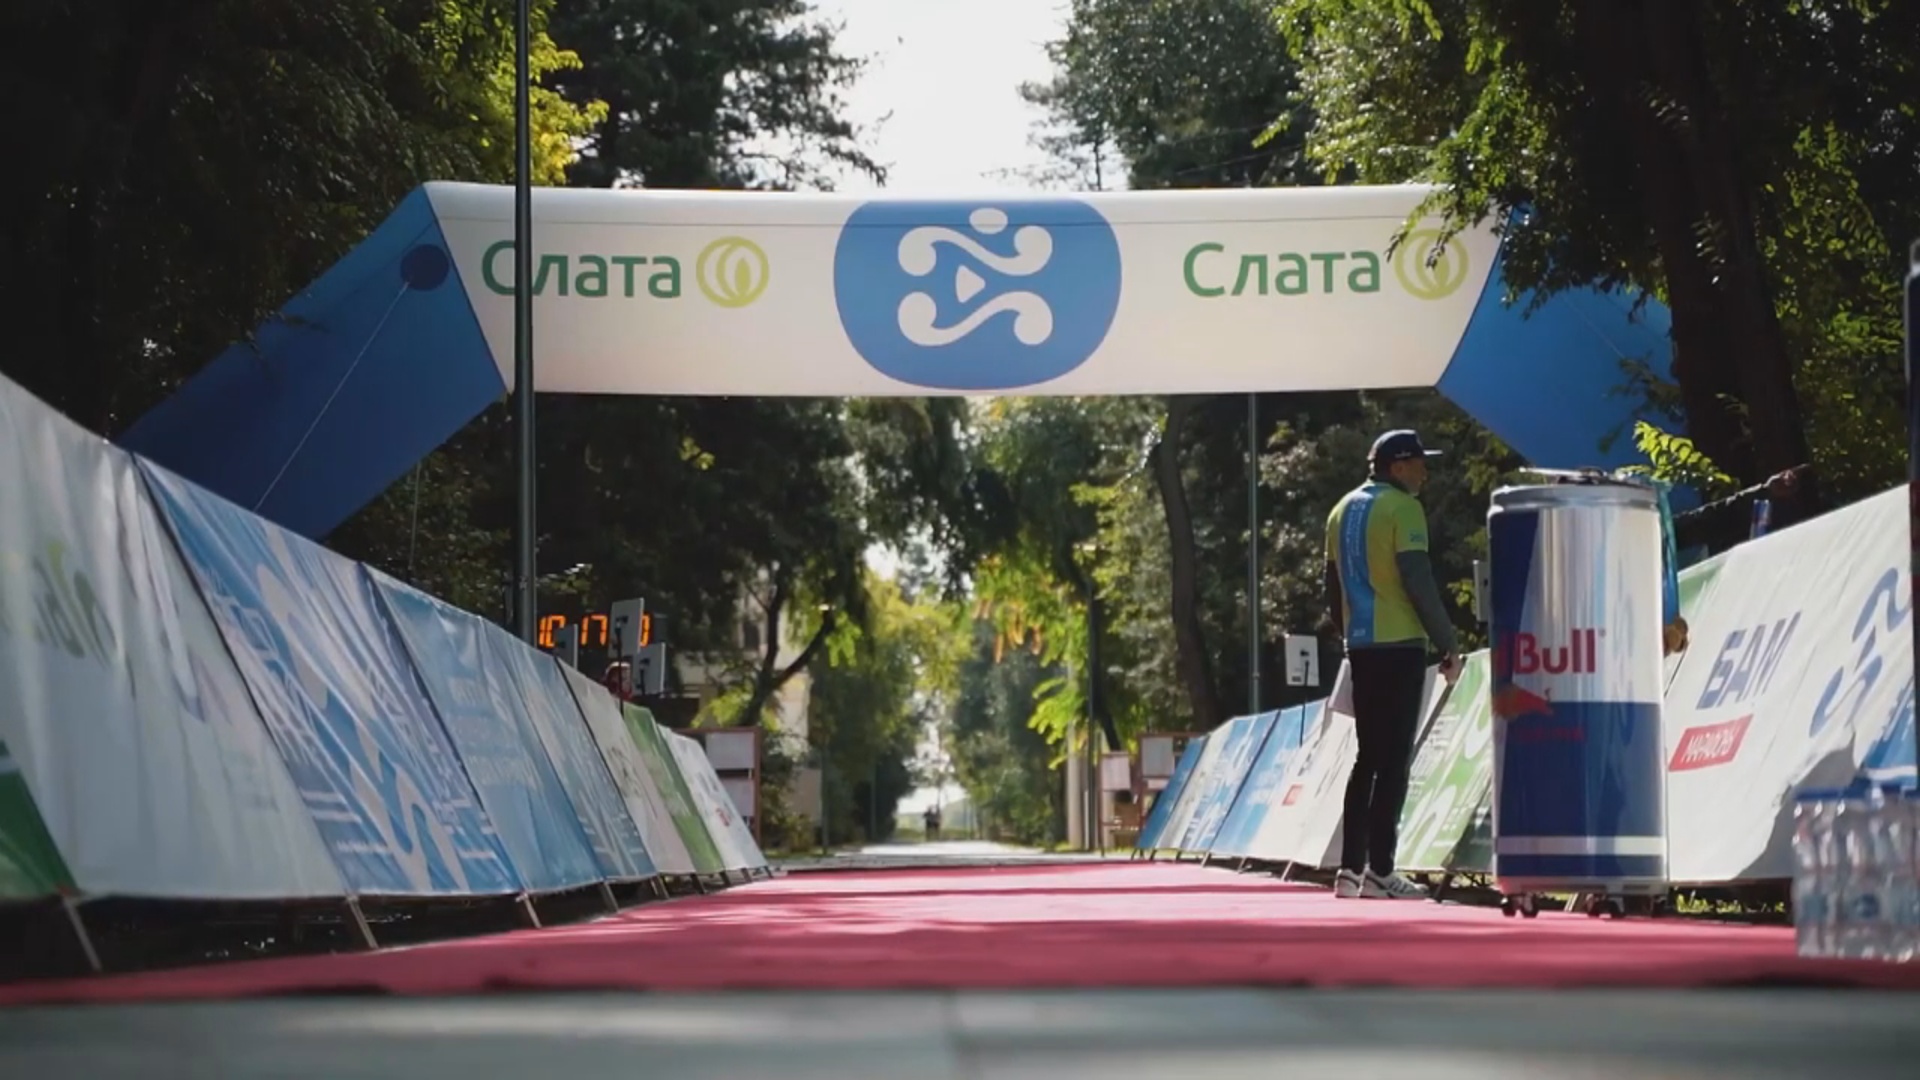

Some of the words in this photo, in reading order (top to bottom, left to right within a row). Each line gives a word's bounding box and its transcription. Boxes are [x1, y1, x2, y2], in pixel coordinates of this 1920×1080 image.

[482, 239, 681, 298] Слата
[1183, 242, 1381, 297] Слата
[1515, 628, 1595, 675] Bull
[1696, 610, 1801, 710] БАМ
